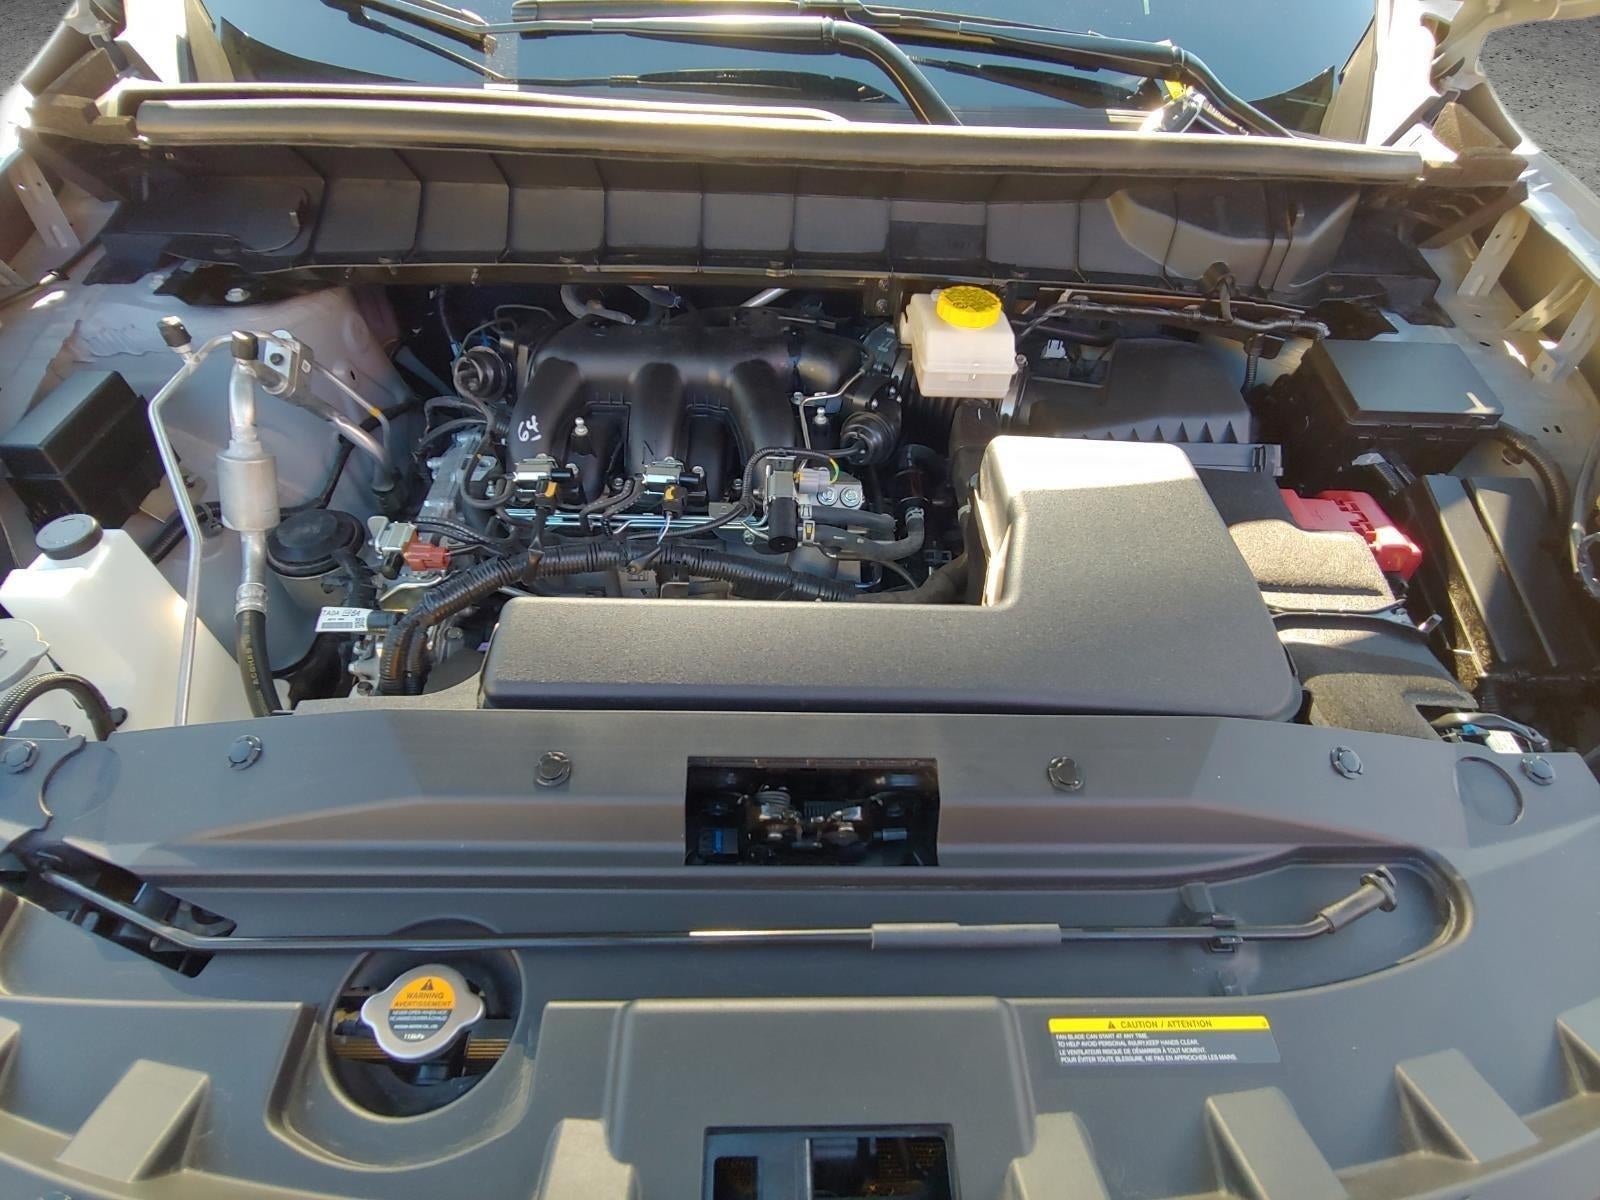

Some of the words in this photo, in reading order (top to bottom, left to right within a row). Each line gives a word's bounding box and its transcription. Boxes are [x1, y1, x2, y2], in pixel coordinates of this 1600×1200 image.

[1120, 1020, 1159, 1029] CAUTION
[1167, 1019, 1213, 1028] ATTENTION
[1067, 1048, 1102, 1056] VENTILATEUR
[1174, 1054, 1208, 1062] APPROCHER
